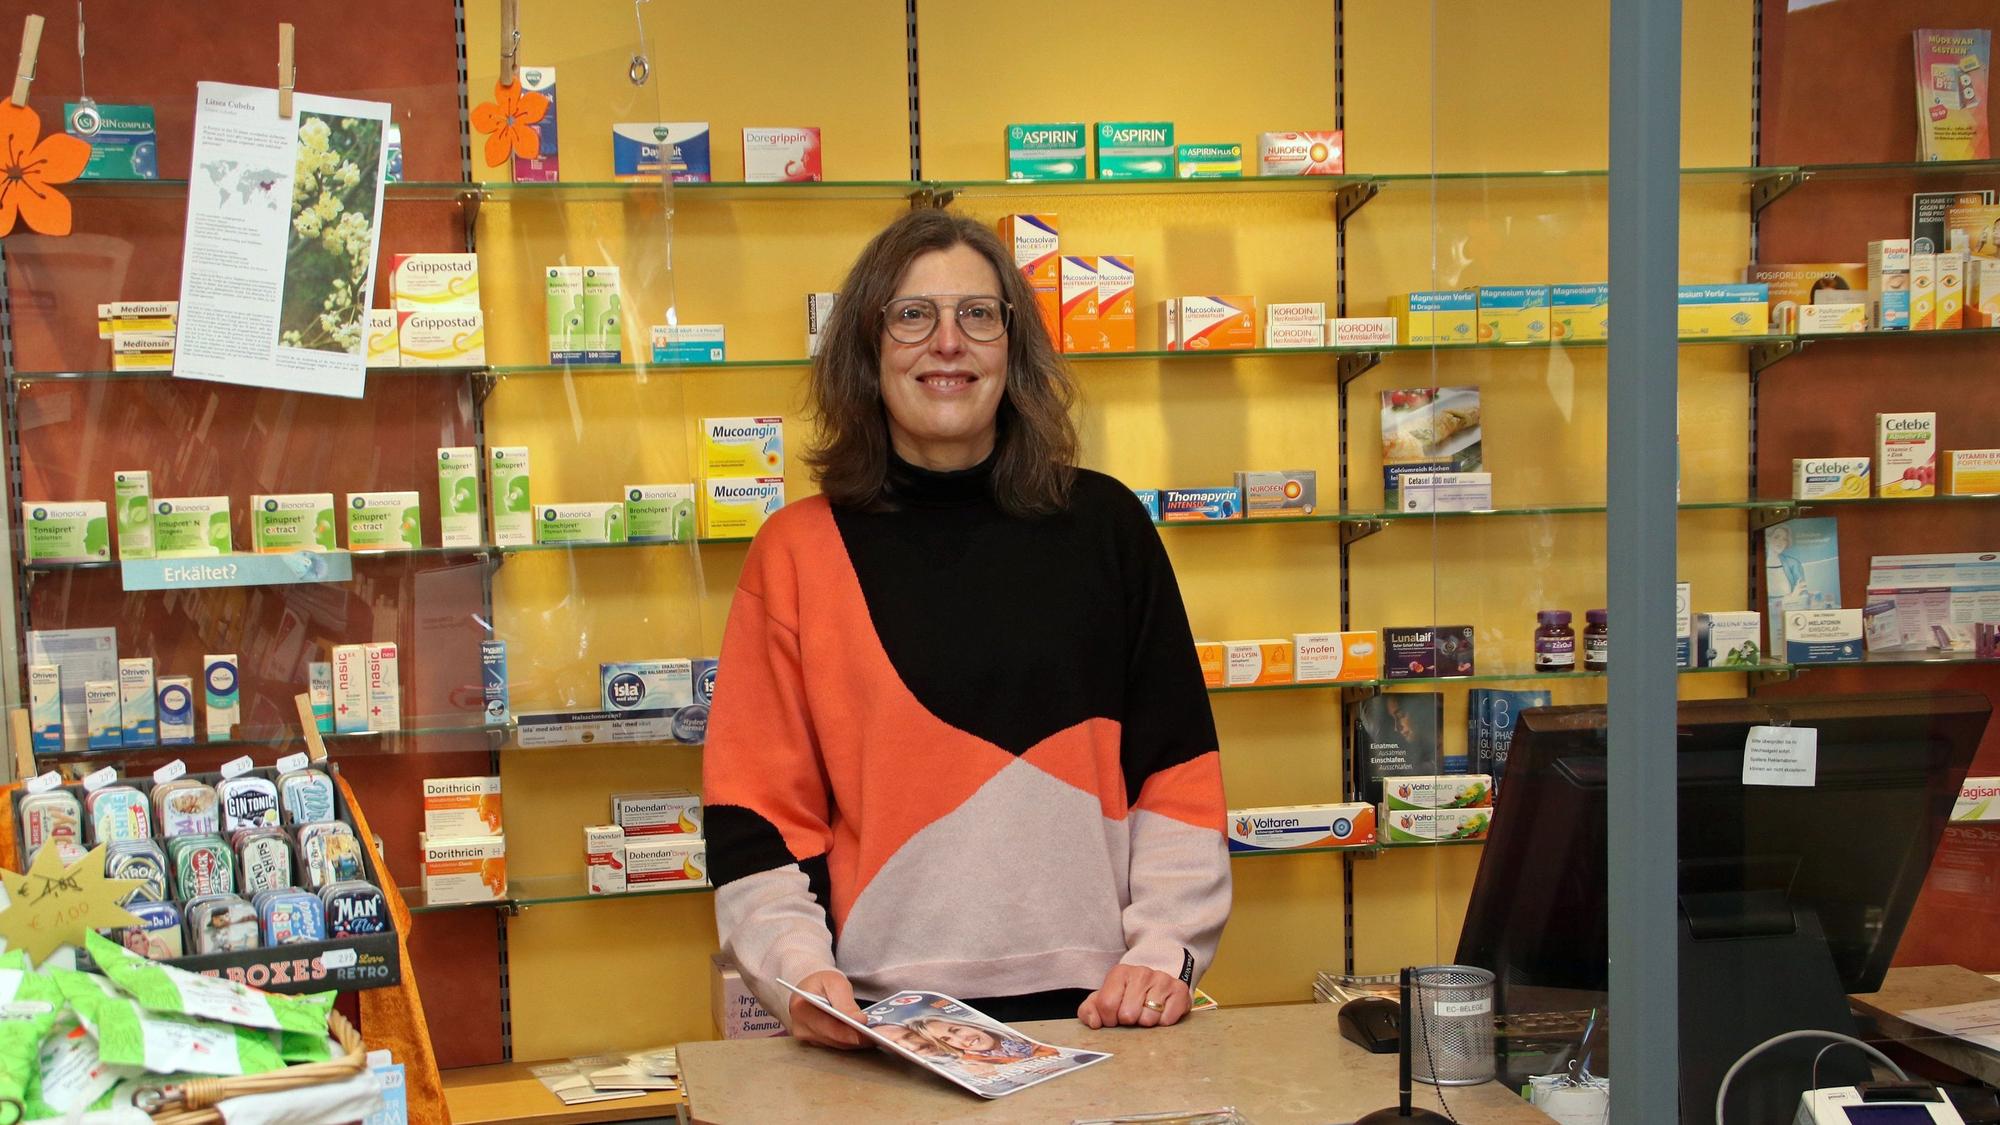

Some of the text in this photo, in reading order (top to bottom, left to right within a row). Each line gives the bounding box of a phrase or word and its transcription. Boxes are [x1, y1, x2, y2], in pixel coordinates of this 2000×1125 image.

[746, 133, 807, 144] Doregrippin
[1023, 130, 1077, 144] ASPIRIN
[1113, 129, 1165, 143] ASPIRIN
[1268, 146, 1308, 154] NUROFEN
[1016, 236, 1057, 244] Mucosolvan
[406, 260, 472, 274] Grippostad
[1481, 288, 1545, 298] Magnesium Verla
[1553, 286, 1596, 296] Magnesium
[1704, 289, 1725, 298] Verla
[1411, 293, 1472, 302] Magnesium Verla
[1185, 306, 1225, 314] Mucosolvan
[1273, 307, 1313, 316] KORODIN
[411, 317, 476, 330] Grippostad
[1338, 323, 1383, 333] KORODIN
[1273, 328, 1312, 338] KORODIN
[123, 340, 170, 348] Meditonsin
[1885, 418, 1930, 431] Cetebe
[712, 425, 777, 439] Mucoangin
[1805, 462, 1850, 475] Cetebe
[713, 484, 778, 499] Mucoangin
[1250, 485, 1284, 493] NUROFEN
[644, 491, 677, 499] Bionorica
[1167, 490, 1237, 503] Thomapyrin
[175, 504, 210, 512] Bionorica
[281, 501, 315, 509] Bionorica
[368, 499, 401, 507] Bionorica
[1168, 501, 1206, 509] INTENSIV
[559, 511, 592, 519] Bionorica
[629, 506, 668, 516] Bronchipret
[265, 515, 301, 525] Sinupret
[352, 512, 388, 522] Sinupret
[33, 526, 73, 535] Tonsipret
[265, 525, 297, 534] extract
[352, 522, 384, 531] extract
[164, 563, 237, 582] Erkältet?
[1391, 632, 1432, 643] Lunalaif
[1300, 645, 1335, 655] Synofen
[121, 668, 150, 677] Otriven
[338, 652, 348, 691] nasic
[371, 651, 381, 689] nasic
[87, 690, 116, 699] Otriven
[613, 683, 639, 697] isla
[1494, 699, 1510, 729] 3
[1495, 731, 1514, 740] PHAS
[427, 784, 481, 794] Dorithricin
[228, 794, 275, 816] GIN TONIC
[624, 804, 666, 813] Dobendan
[1253, 817, 1299, 829] Voltaren
[590, 833, 621, 841] Dobendan
[257, 842, 275, 873] SHIPS
[429, 848, 483, 859] Dorithricin
[629, 851, 671, 860] Dobendan
[252, 864, 270, 890] IEND
[334, 895, 381, 925] MAN
[350, 919, 376, 932] Flu
[226, 956, 328, 986] BOXES
[336, 965, 389, 980] RETRO
[740, 1008, 752, 1018] ist
[1446, 1003, 1483, 1013] EC-BELEGE
